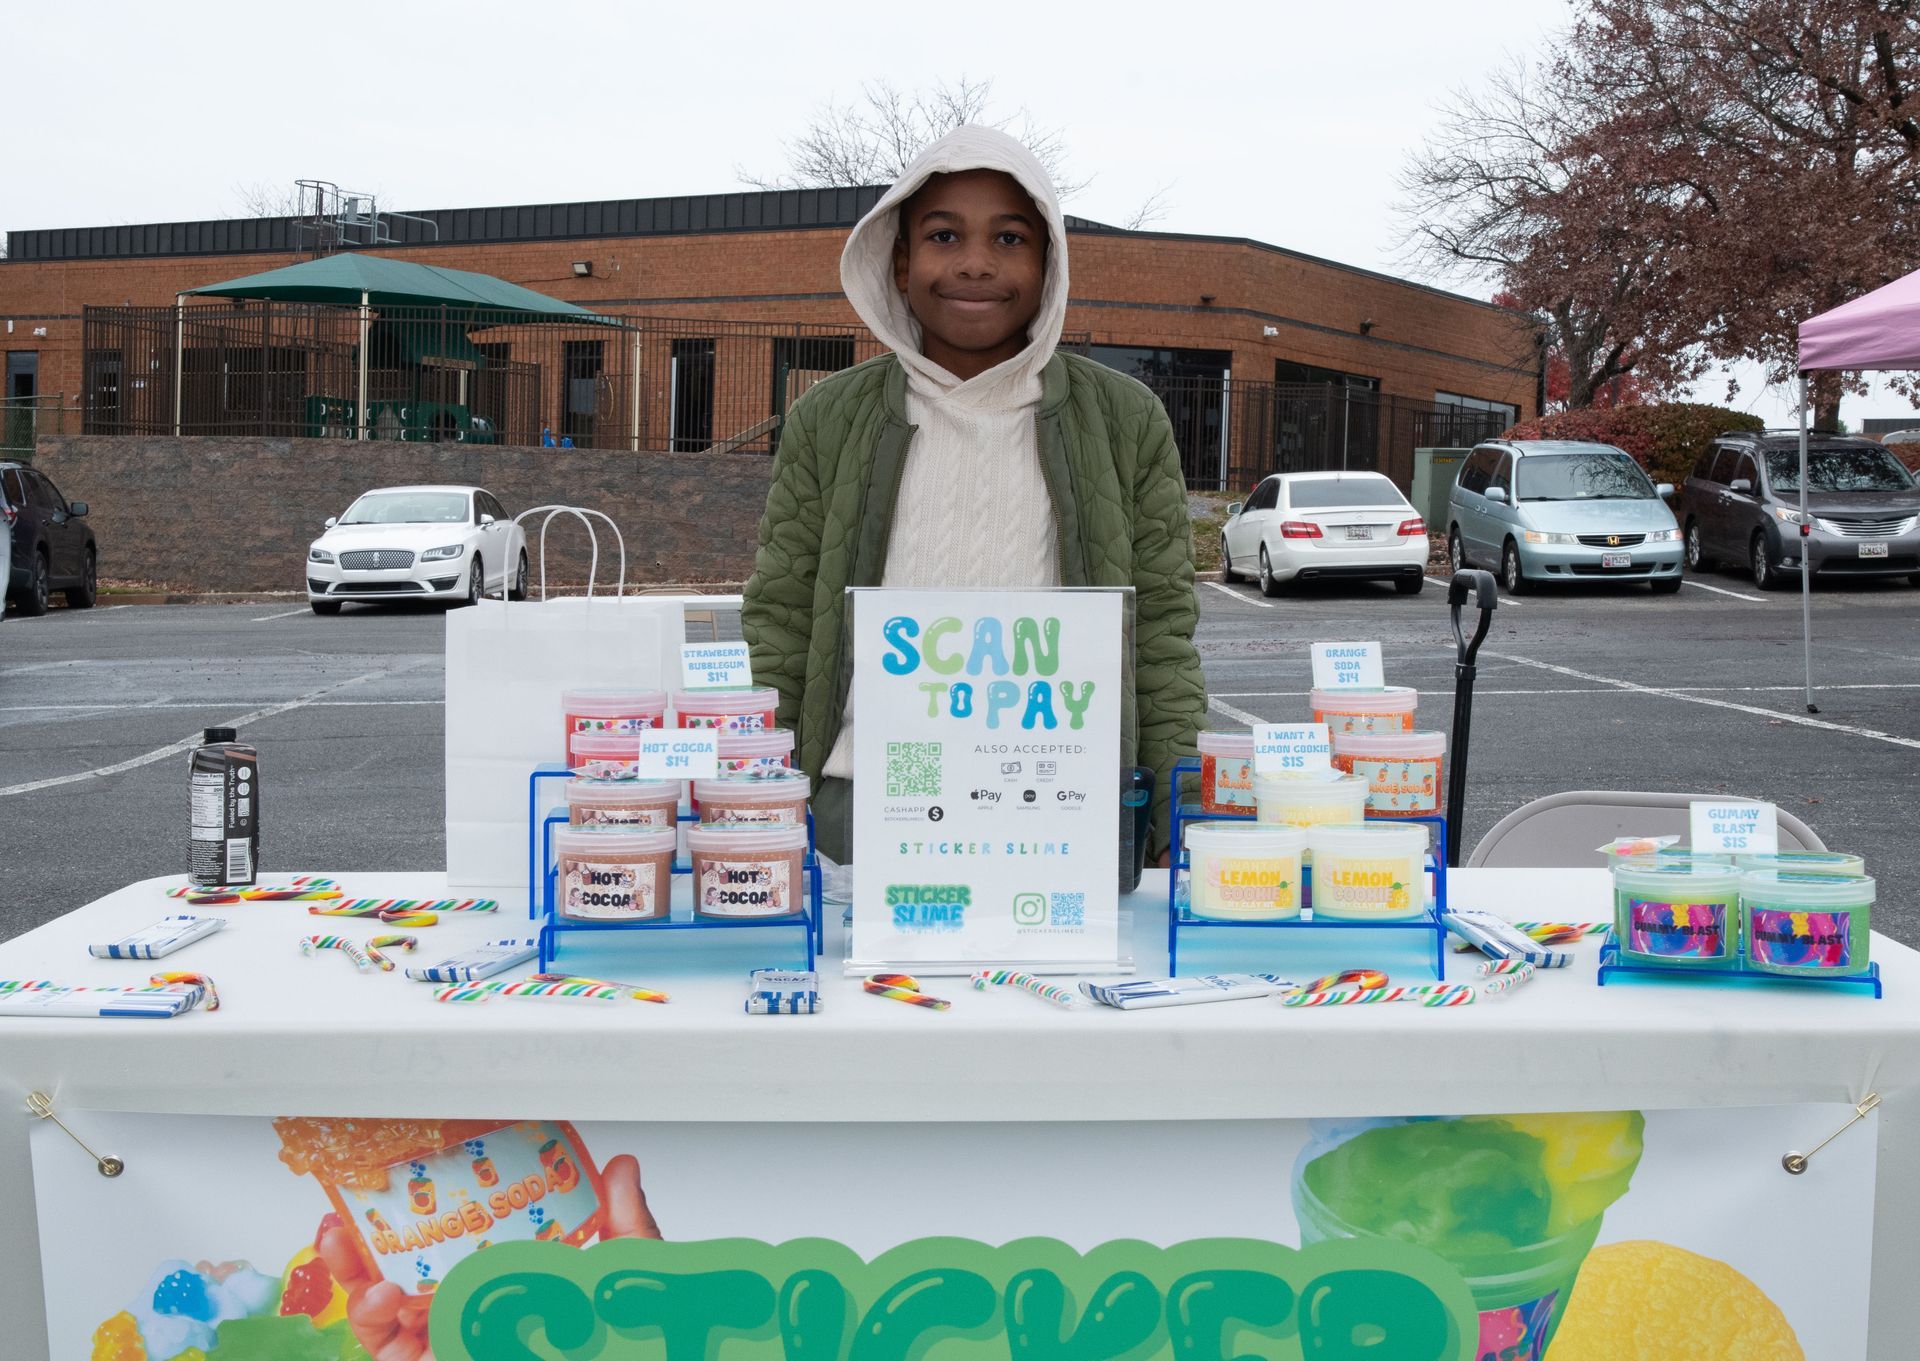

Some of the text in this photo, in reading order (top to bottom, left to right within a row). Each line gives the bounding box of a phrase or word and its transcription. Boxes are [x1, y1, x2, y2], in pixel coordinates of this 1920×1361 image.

[683, 648, 746, 658] STRAWBERRY
[882, 616, 1061, 676] SCAN
[1325, 648, 1368, 658] ORANGE
[688, 661, 745, 671] BUBBLEGUM
[1334, 661, 1361, 670] SODA
[707, 671, 728, 682] $14
[1338, 673, 1359, 683] $14
[918, 680, 1096, 730] TO PAY
[1274, 731, 1305, 740] WANT
[1308, 731, 1316, 740] A
[642, 742, 713, 753] HOT COCOA
[974, 744, 1087, 754] ALSO ACCEPTED:
[1255, 744, 1329, 754] LEMON COOKIE
[665, 755, 689, 767] $14
[1281, 755, 1305, 767] $15
[980, 789, 1002, 803] Pay
[228, 807, 236, 829] Fueled
[1707, 808, 1760, 819] GUMMY
[1712, 823, 1756, 834] BLAST
[899, 842, 1070, 855] STICKER SLIME
[1722, 836, 1748, 848] $15
[591, 871, 624, 886] HOT
[727, 870, 761, 884] HOT
[1220, 869, 1281, 886] LEMON
[1333, 870, 1393, 886] LEMON
[582, 891, 632, 907] COCOA
[719, 890, 769, 905] COCOA
[886, 886, 971, 906] STICKER
[1220, 886, 1281, 902] COOKIE
[1333, 886, 1393, 903] COOKIE
[893, 905, 963, 924] SLIME
[1634, 921, 1721, 936] GUMMY BLAST
[1755, 931, 1844, 946] GUMMY BLAST
[370, 1166, 565, 1255] ORANGE SODA
